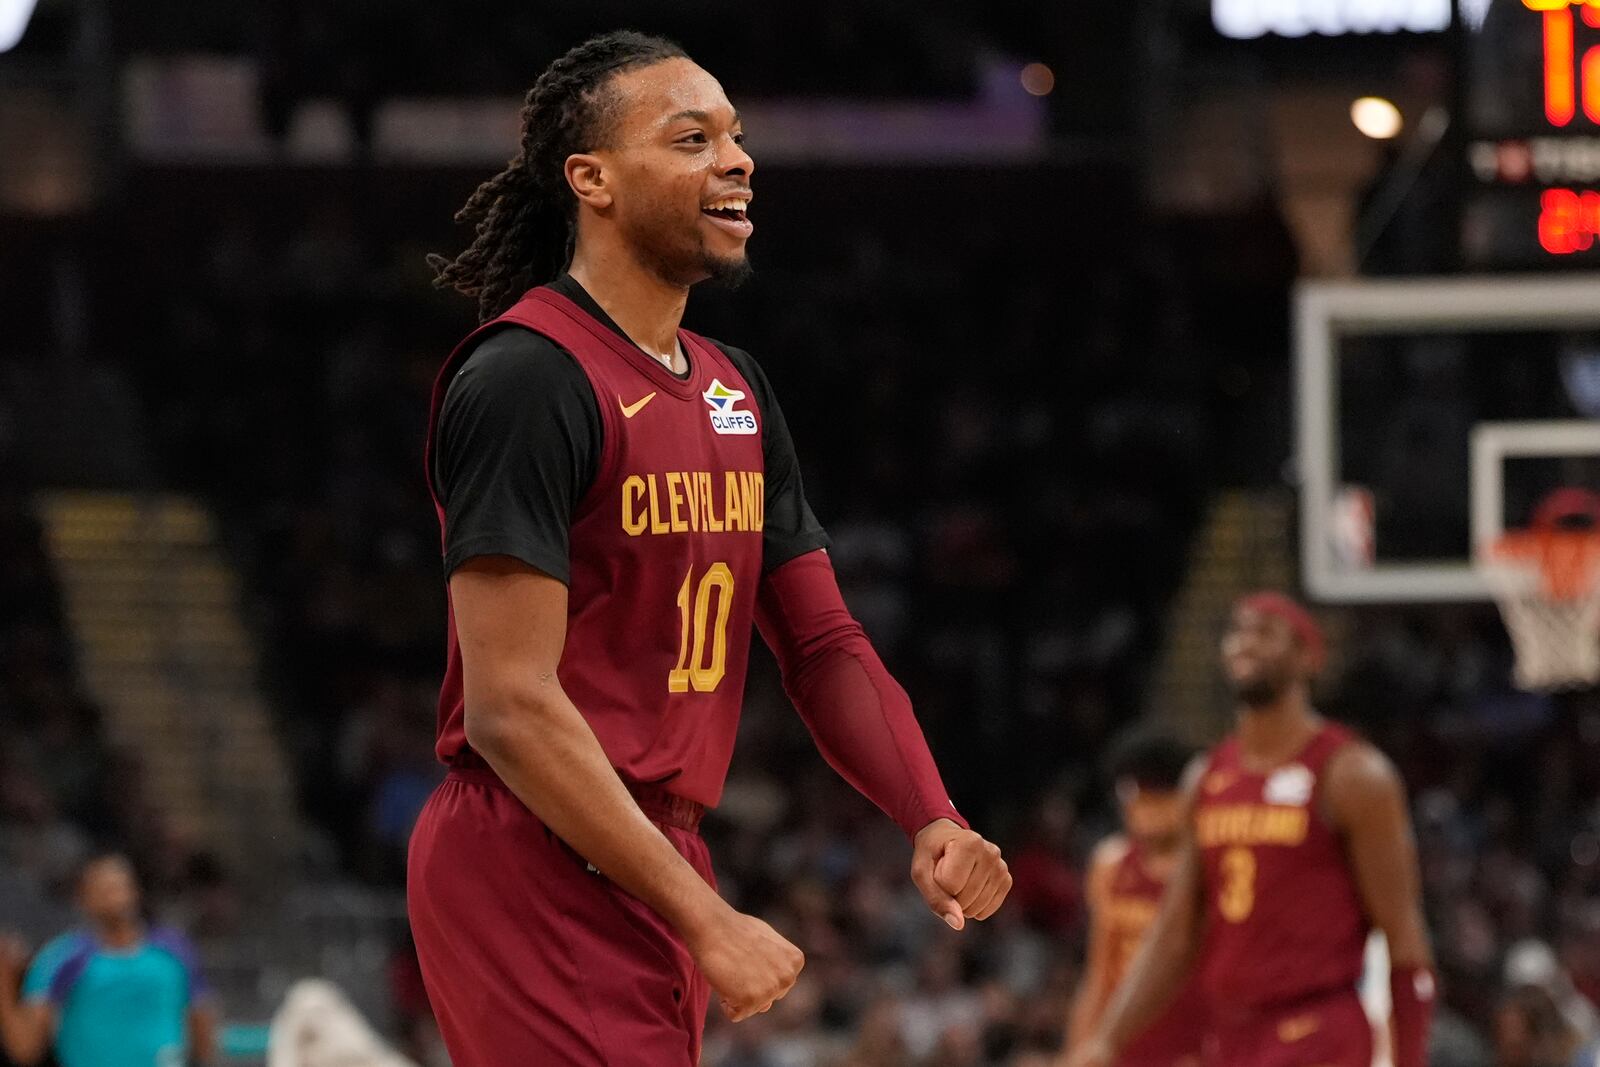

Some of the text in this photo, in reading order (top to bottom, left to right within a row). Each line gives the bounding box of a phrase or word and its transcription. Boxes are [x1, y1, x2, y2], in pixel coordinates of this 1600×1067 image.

[712, 414, 756, 430] CLIFFS
[621, 471, 764, 537] CLEVELAND
[668, 562, 735, 693] 10
